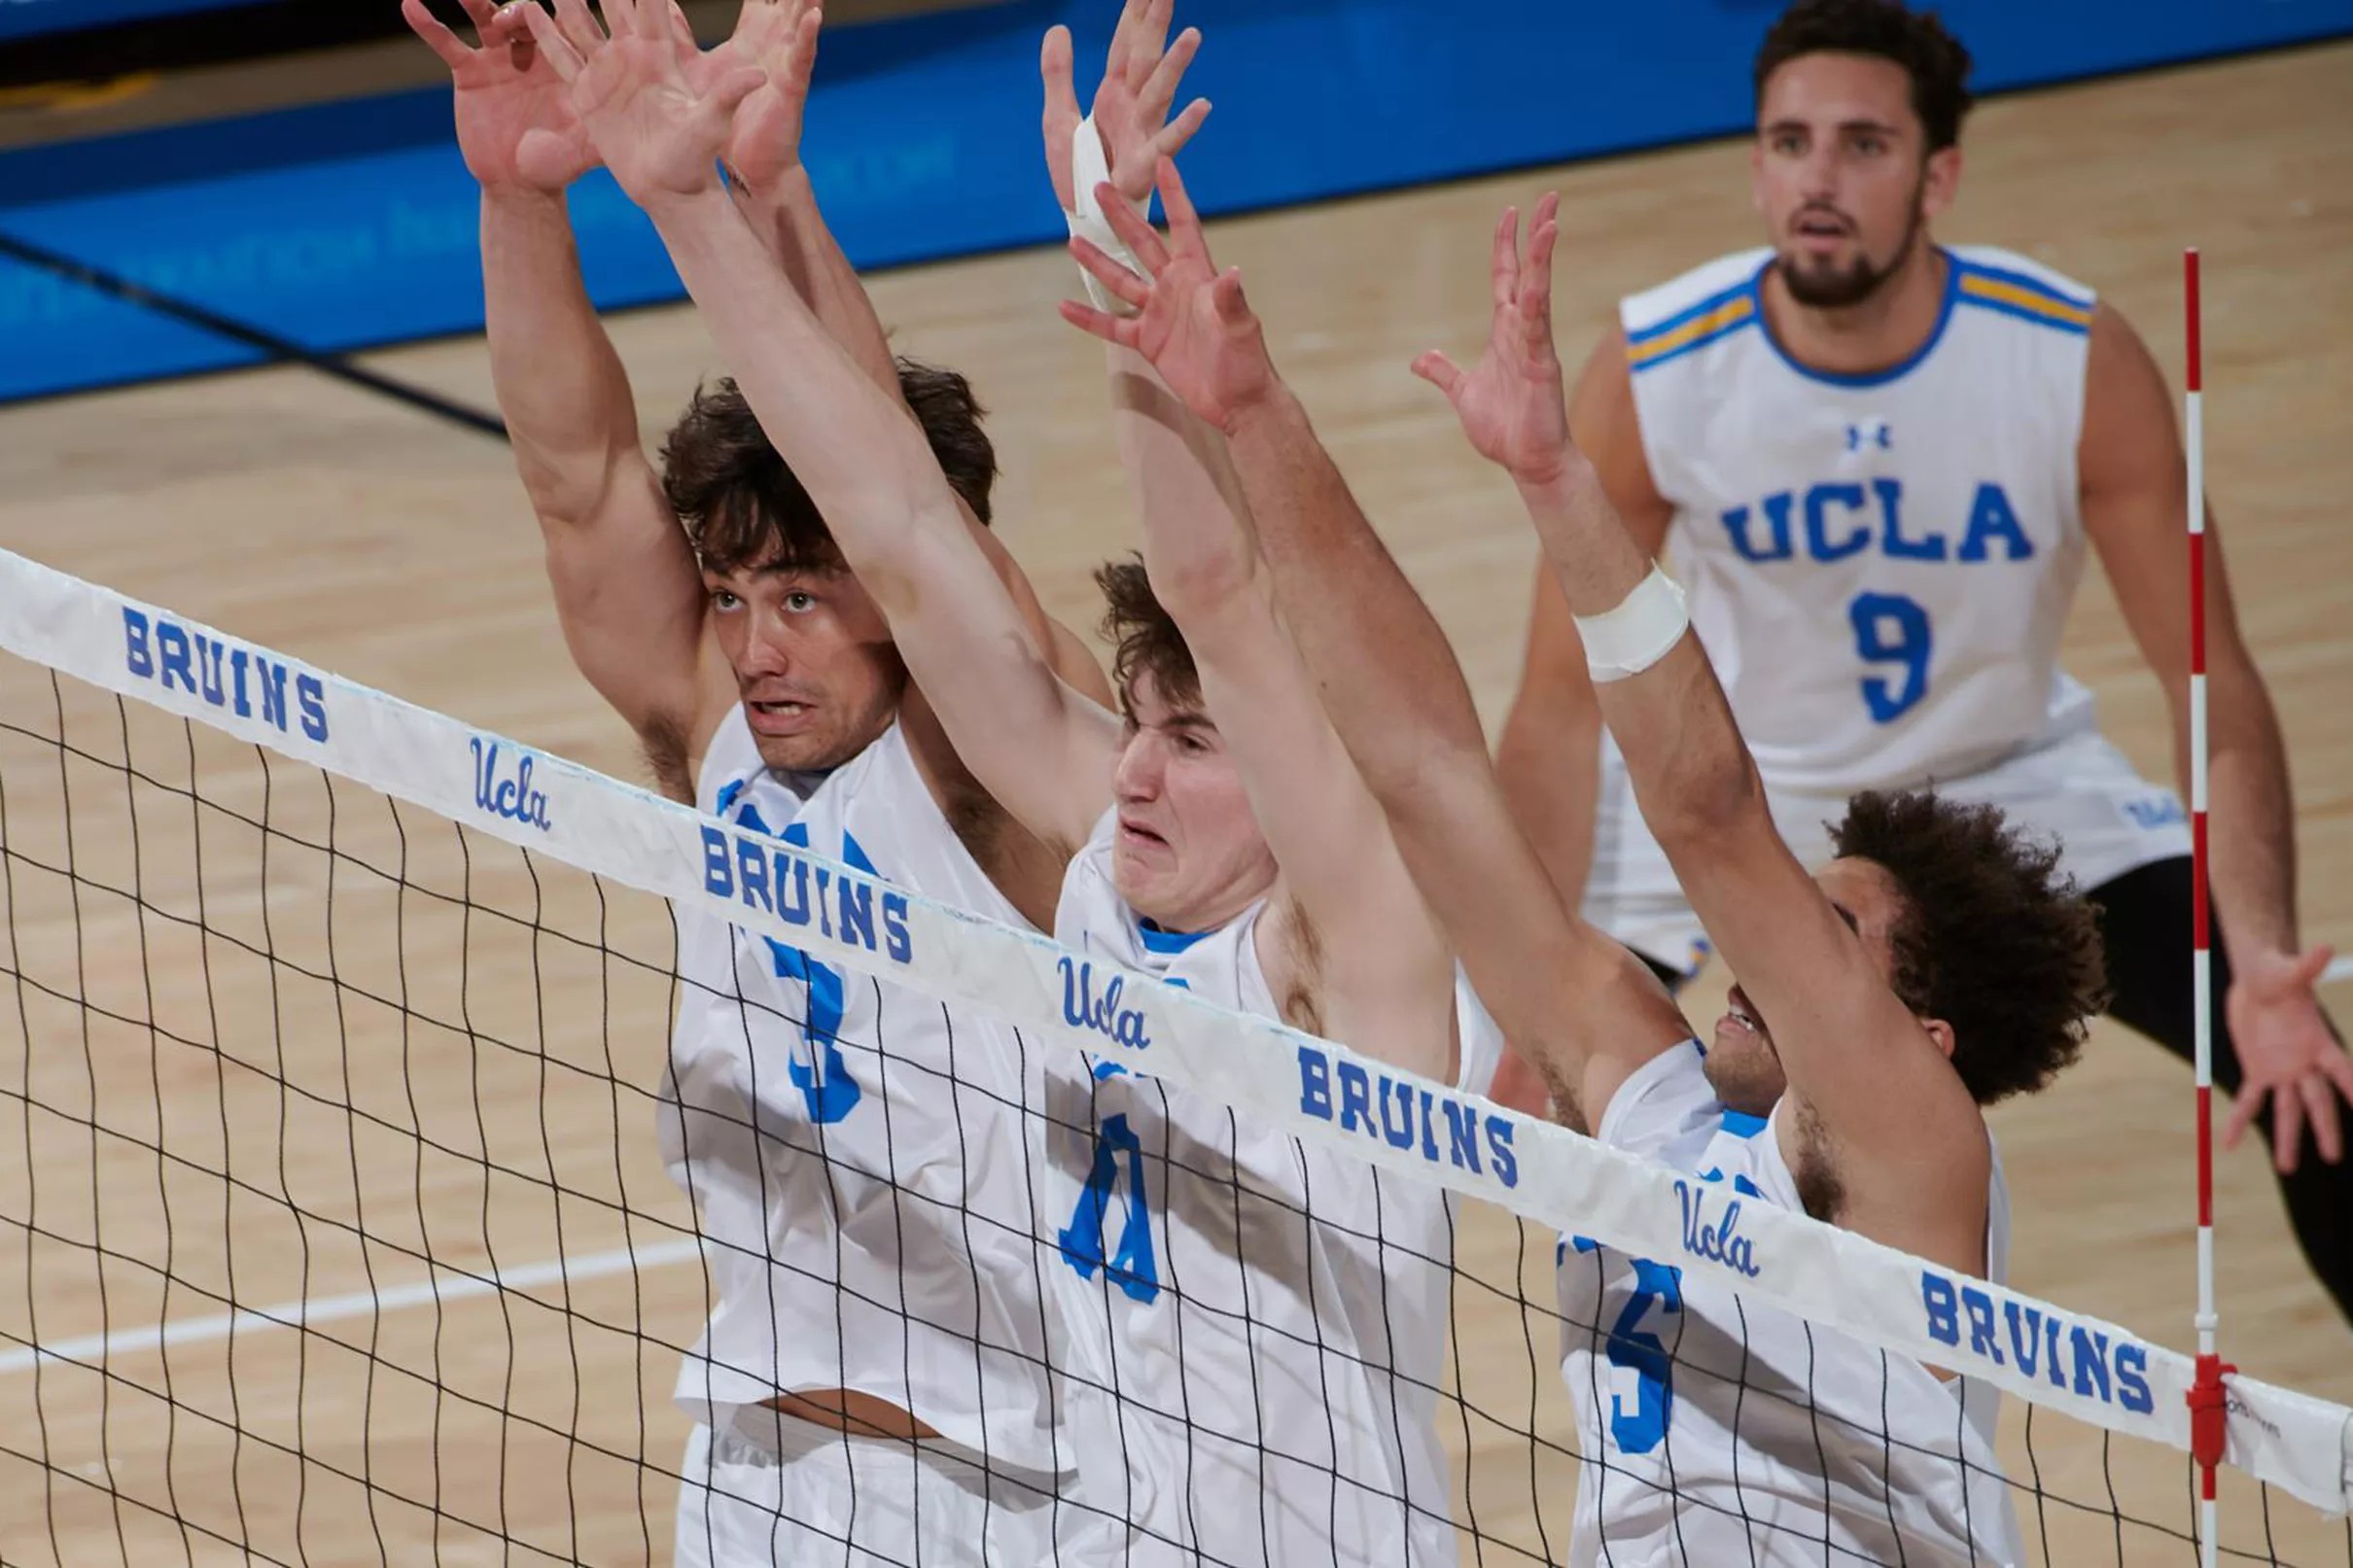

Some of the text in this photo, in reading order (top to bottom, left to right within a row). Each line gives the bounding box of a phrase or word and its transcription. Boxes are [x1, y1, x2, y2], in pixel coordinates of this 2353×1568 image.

[1721, 476, 2033, 565] UCLA
[121, 607, 329, 744] BRUINS
[1846, 590, 1934, 724] 9
[470, 736, 551, 832] Ucla
[700, 823, 912, 963] BRUINS
[761, 934, 861, 1125] 3
[1057, 956, 1150, 1050] Ucla
[1297, 1041, 1519, 1189] BRUINS
[1673, 1178, 1760, 1278] Ucla
[1606, 1257, 1684, 1455] 5
[1921, 1270, 2154, 1415] BRUINS
